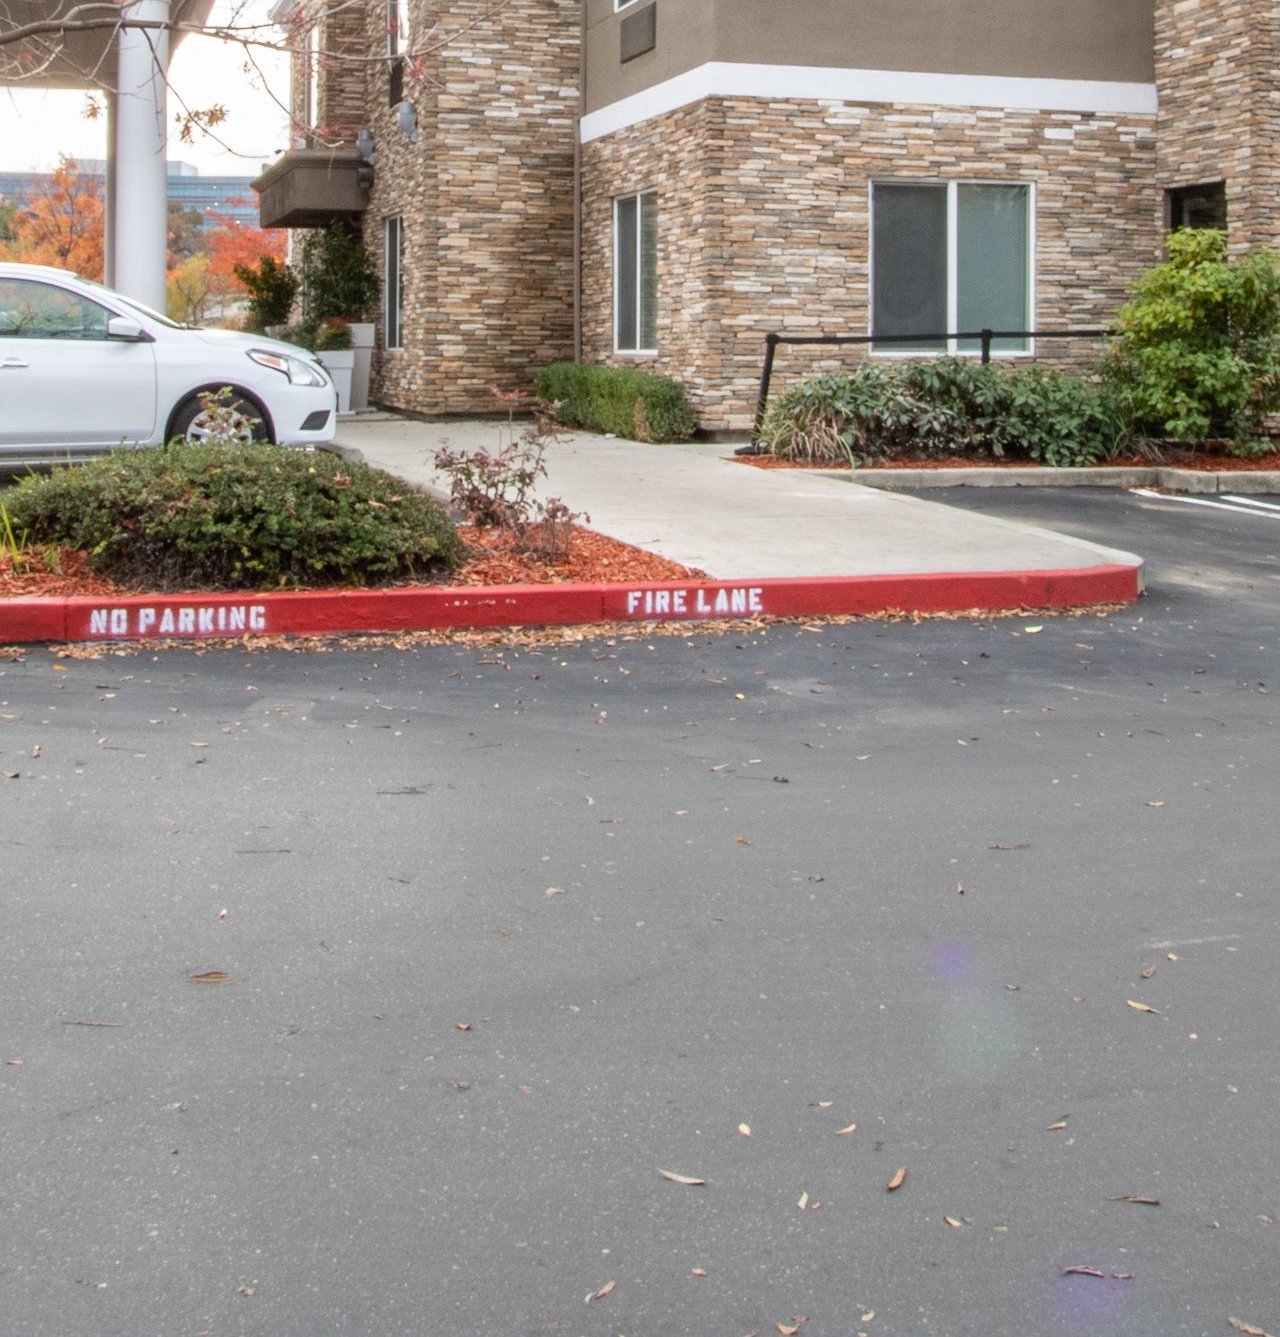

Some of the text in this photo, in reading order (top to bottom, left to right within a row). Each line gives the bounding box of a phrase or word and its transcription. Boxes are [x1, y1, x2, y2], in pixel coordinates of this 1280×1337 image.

[628, 588, 763, 614] FIRE LANE
[90, 606, 266, 634] NO PARKING
